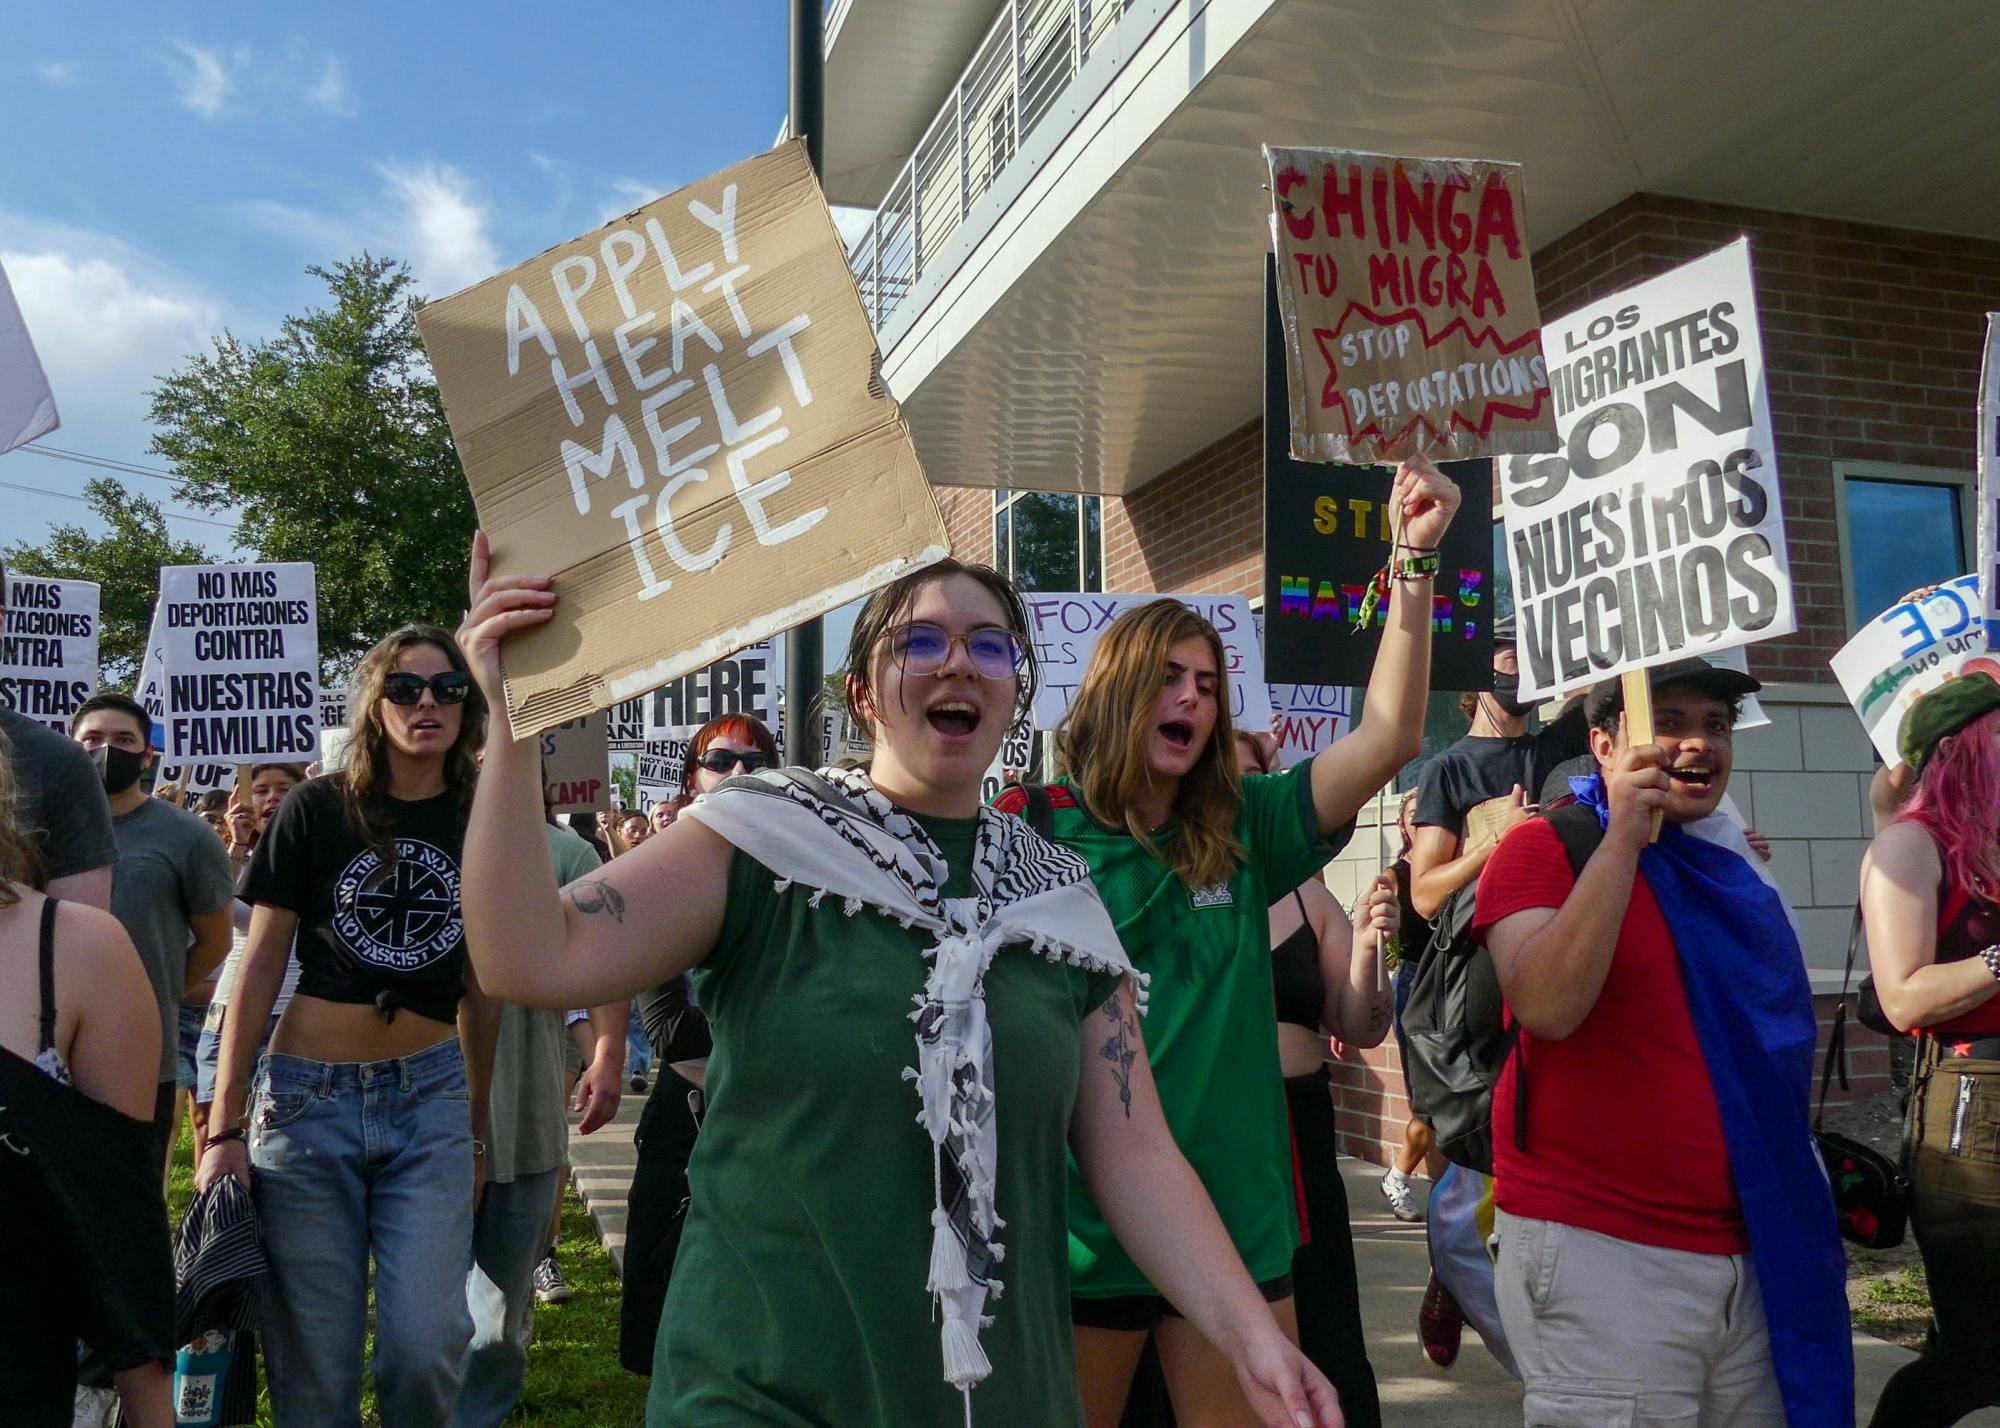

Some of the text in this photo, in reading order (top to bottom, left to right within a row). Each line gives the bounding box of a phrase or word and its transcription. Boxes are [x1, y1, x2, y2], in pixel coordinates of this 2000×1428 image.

[1276, 160, 1522, 259] CHINGA
[506, 183, 738, 376] APPLY
[1293, 251, 1506, 318] TU MIGRA
[550, 264, 752, 427] HEAT
[1341, 324, 1411, 367] STOP
[1564, 304, 1641, 354] LOS
[559, 314, 813, 515] MELT
[1347, 355, 1548, 424] DEPORTATIONS
[1509, 358, 1753, 508] SON
[610, 427, 829, 601] ICE
[1512, 448, 1768, 601] NUESTROS
[12, 582, 62, 610] MAS
[198, 570, 278, 599] NO MAS
[168, 600, 309, 628] DEPORTACIONES
[1030, 600, 1118, 633] FOX
[1522, 533, 1778, 690] VECINOS
[195, 629, 285, 661] CONTRA
[1034, 642, 1077, 665] IS
[170, 671, 314, 713] NUESTRAS
[653, 658, 768, 728] HERE
[172, 714, 315, 757] FAMILIAS
[350, 844, 416, 876] TRP
[355, 935, 429, 966] FASCIST
